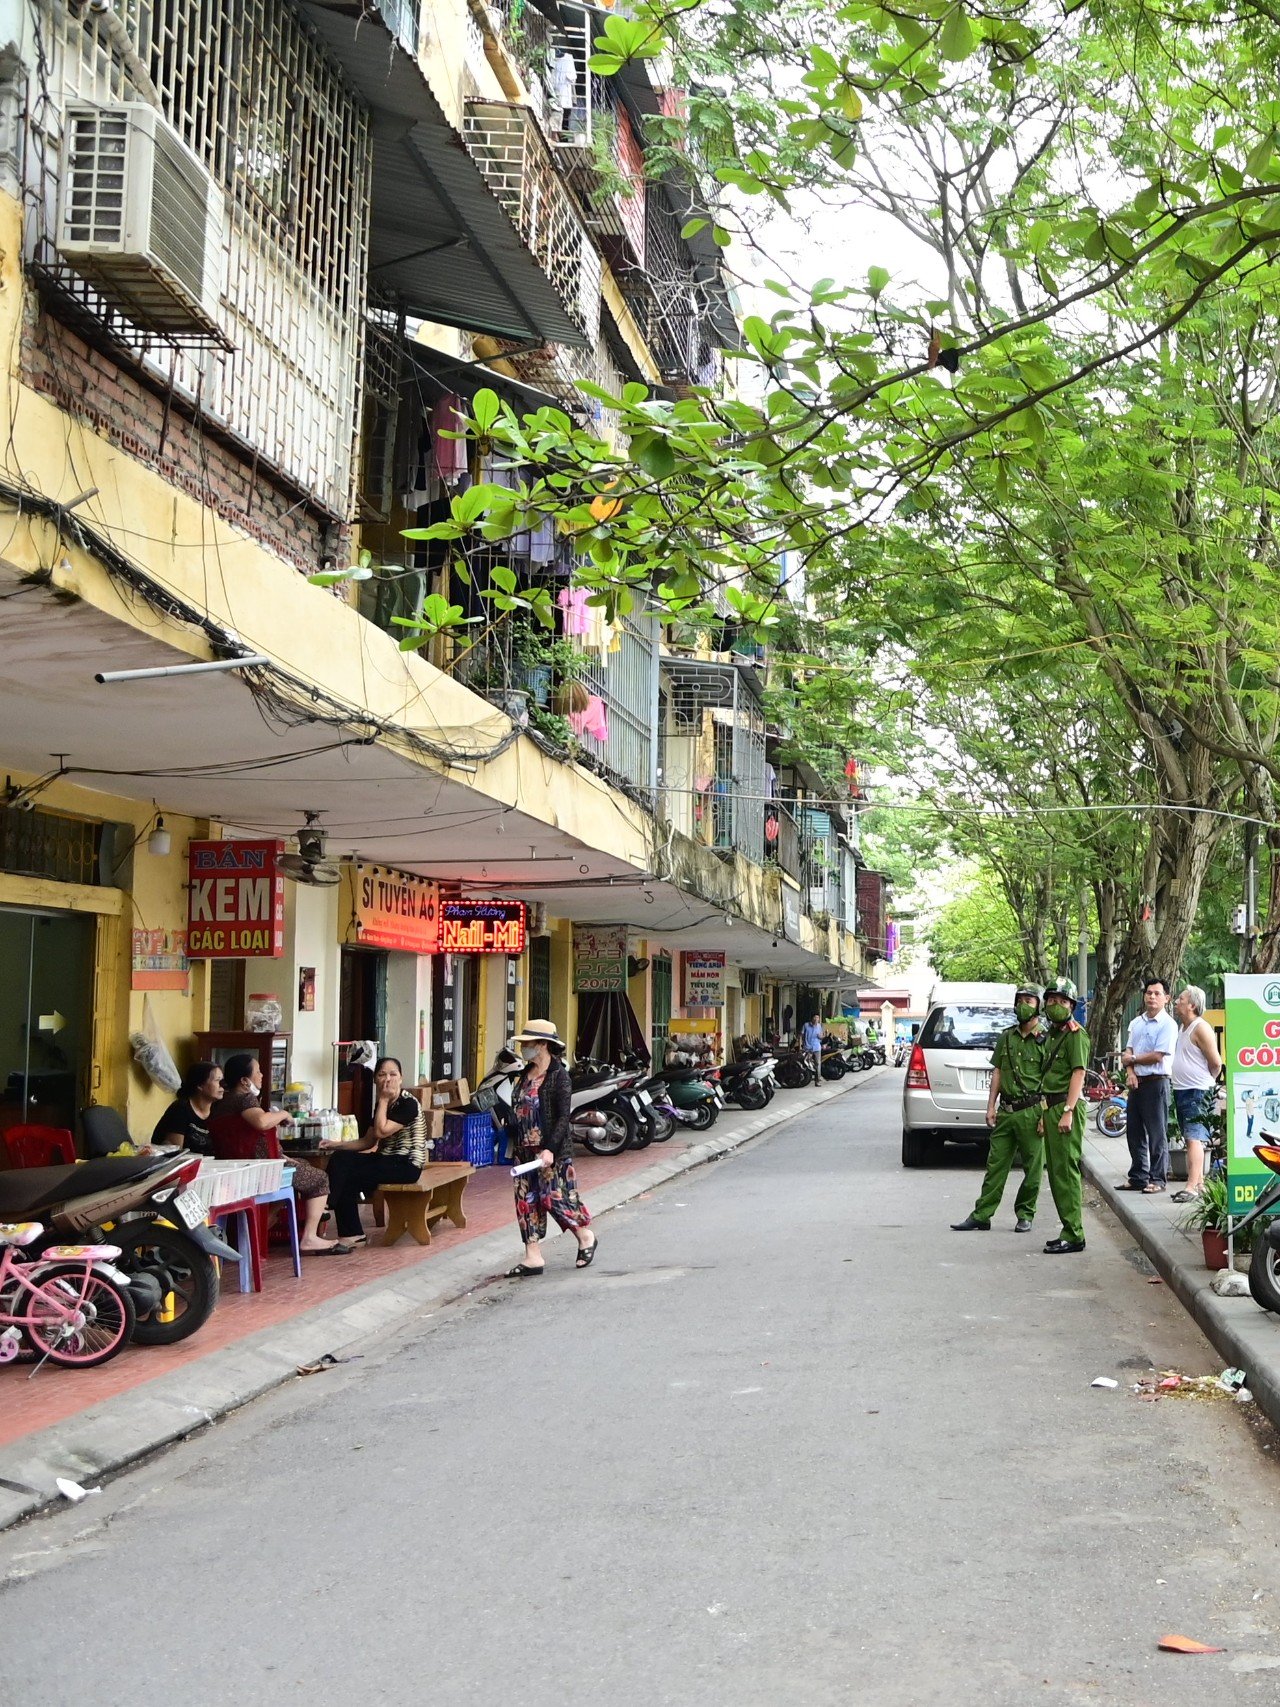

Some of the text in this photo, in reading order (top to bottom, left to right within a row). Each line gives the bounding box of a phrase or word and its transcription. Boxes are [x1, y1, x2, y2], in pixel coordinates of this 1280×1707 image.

[195, 844, 266, 869] BÁN
[191, 877, 270, 921] KEM
[362, 876, 374, 909] SI
[419, 892, 435, 922] A6
[189, 926, 269, 954] CÁC LOẠI
[443, 920, 520, 947] Nail-Mi
[576, 949, 623, 960] PS3
[576, 962, 622, 975] PS4
[578, 978, 621, 990] 2017
